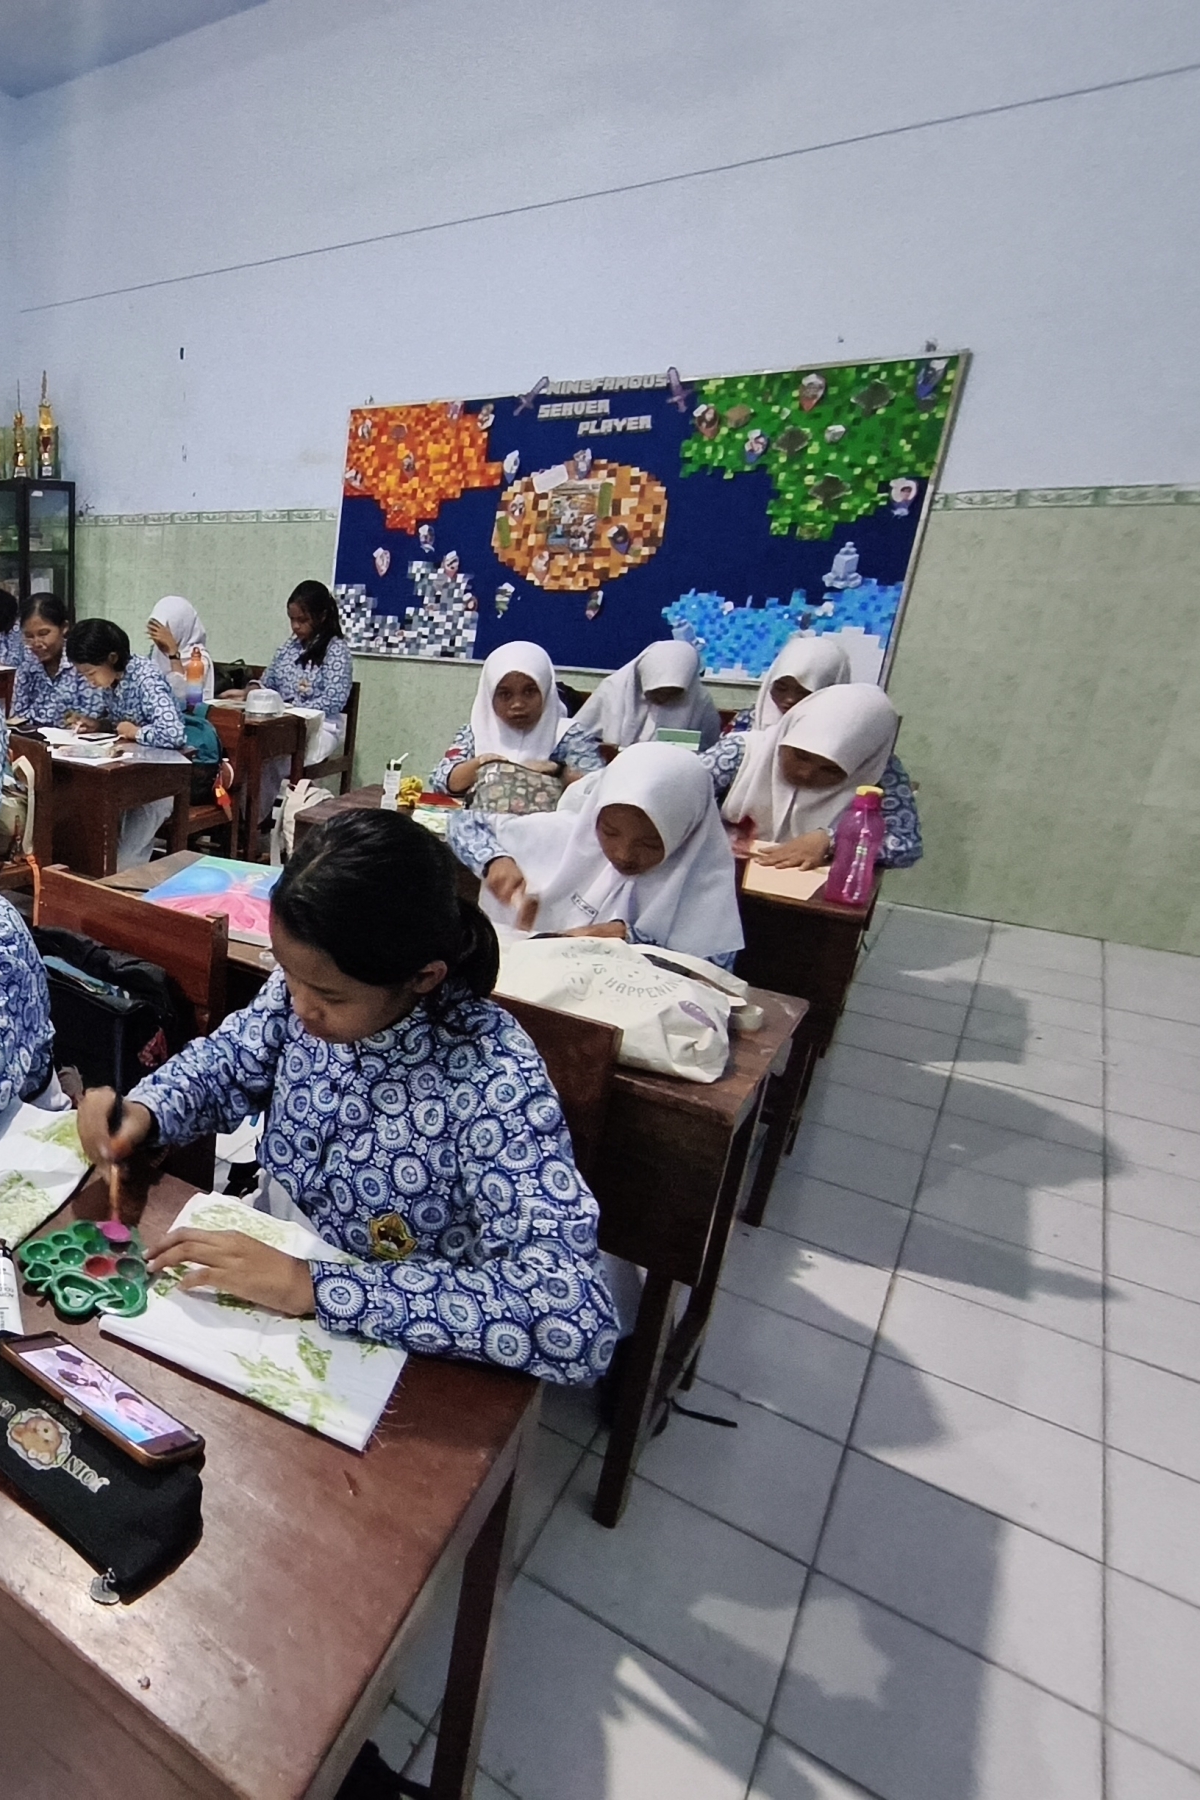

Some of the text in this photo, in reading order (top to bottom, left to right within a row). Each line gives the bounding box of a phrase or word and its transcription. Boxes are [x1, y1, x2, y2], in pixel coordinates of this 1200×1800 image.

[538, 399, 610, 419] SERVER
[577, 415, 652, 437] PLAYER
[61, 1455, 111, 1494] JOIN
